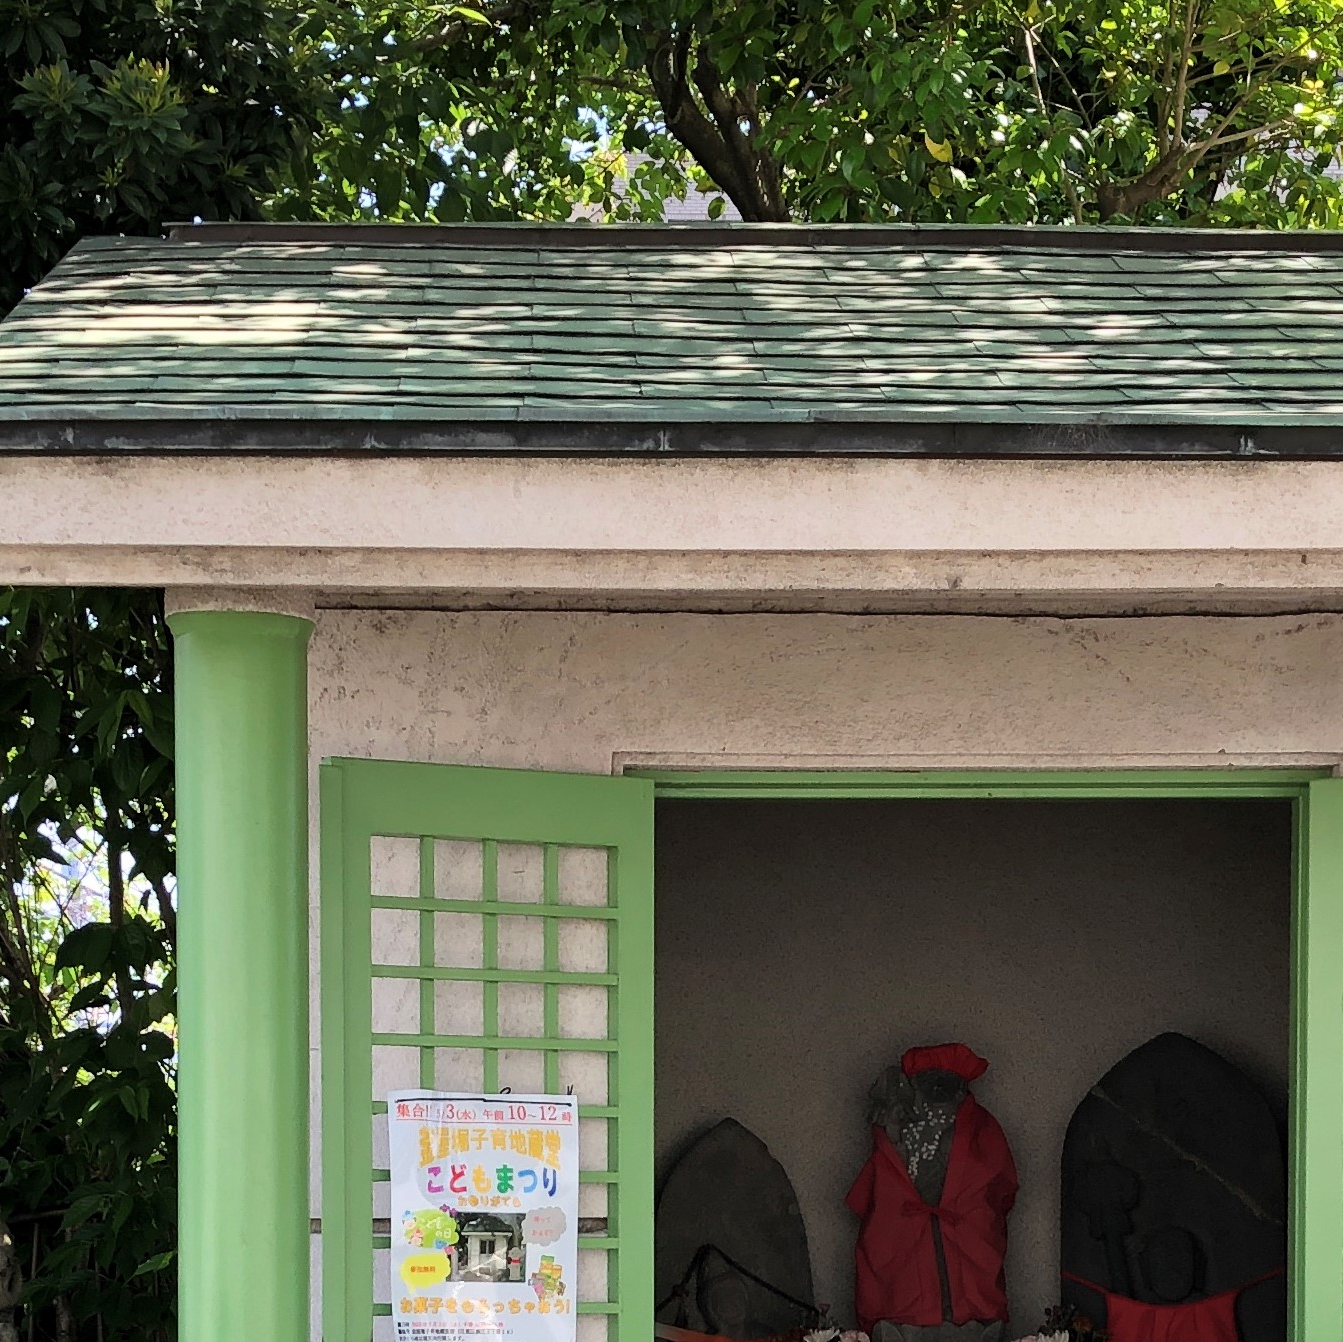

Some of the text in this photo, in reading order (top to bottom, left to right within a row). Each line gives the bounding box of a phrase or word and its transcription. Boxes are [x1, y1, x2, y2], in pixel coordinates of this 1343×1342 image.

[427, 1164, 557, 1197] こどもまつり
